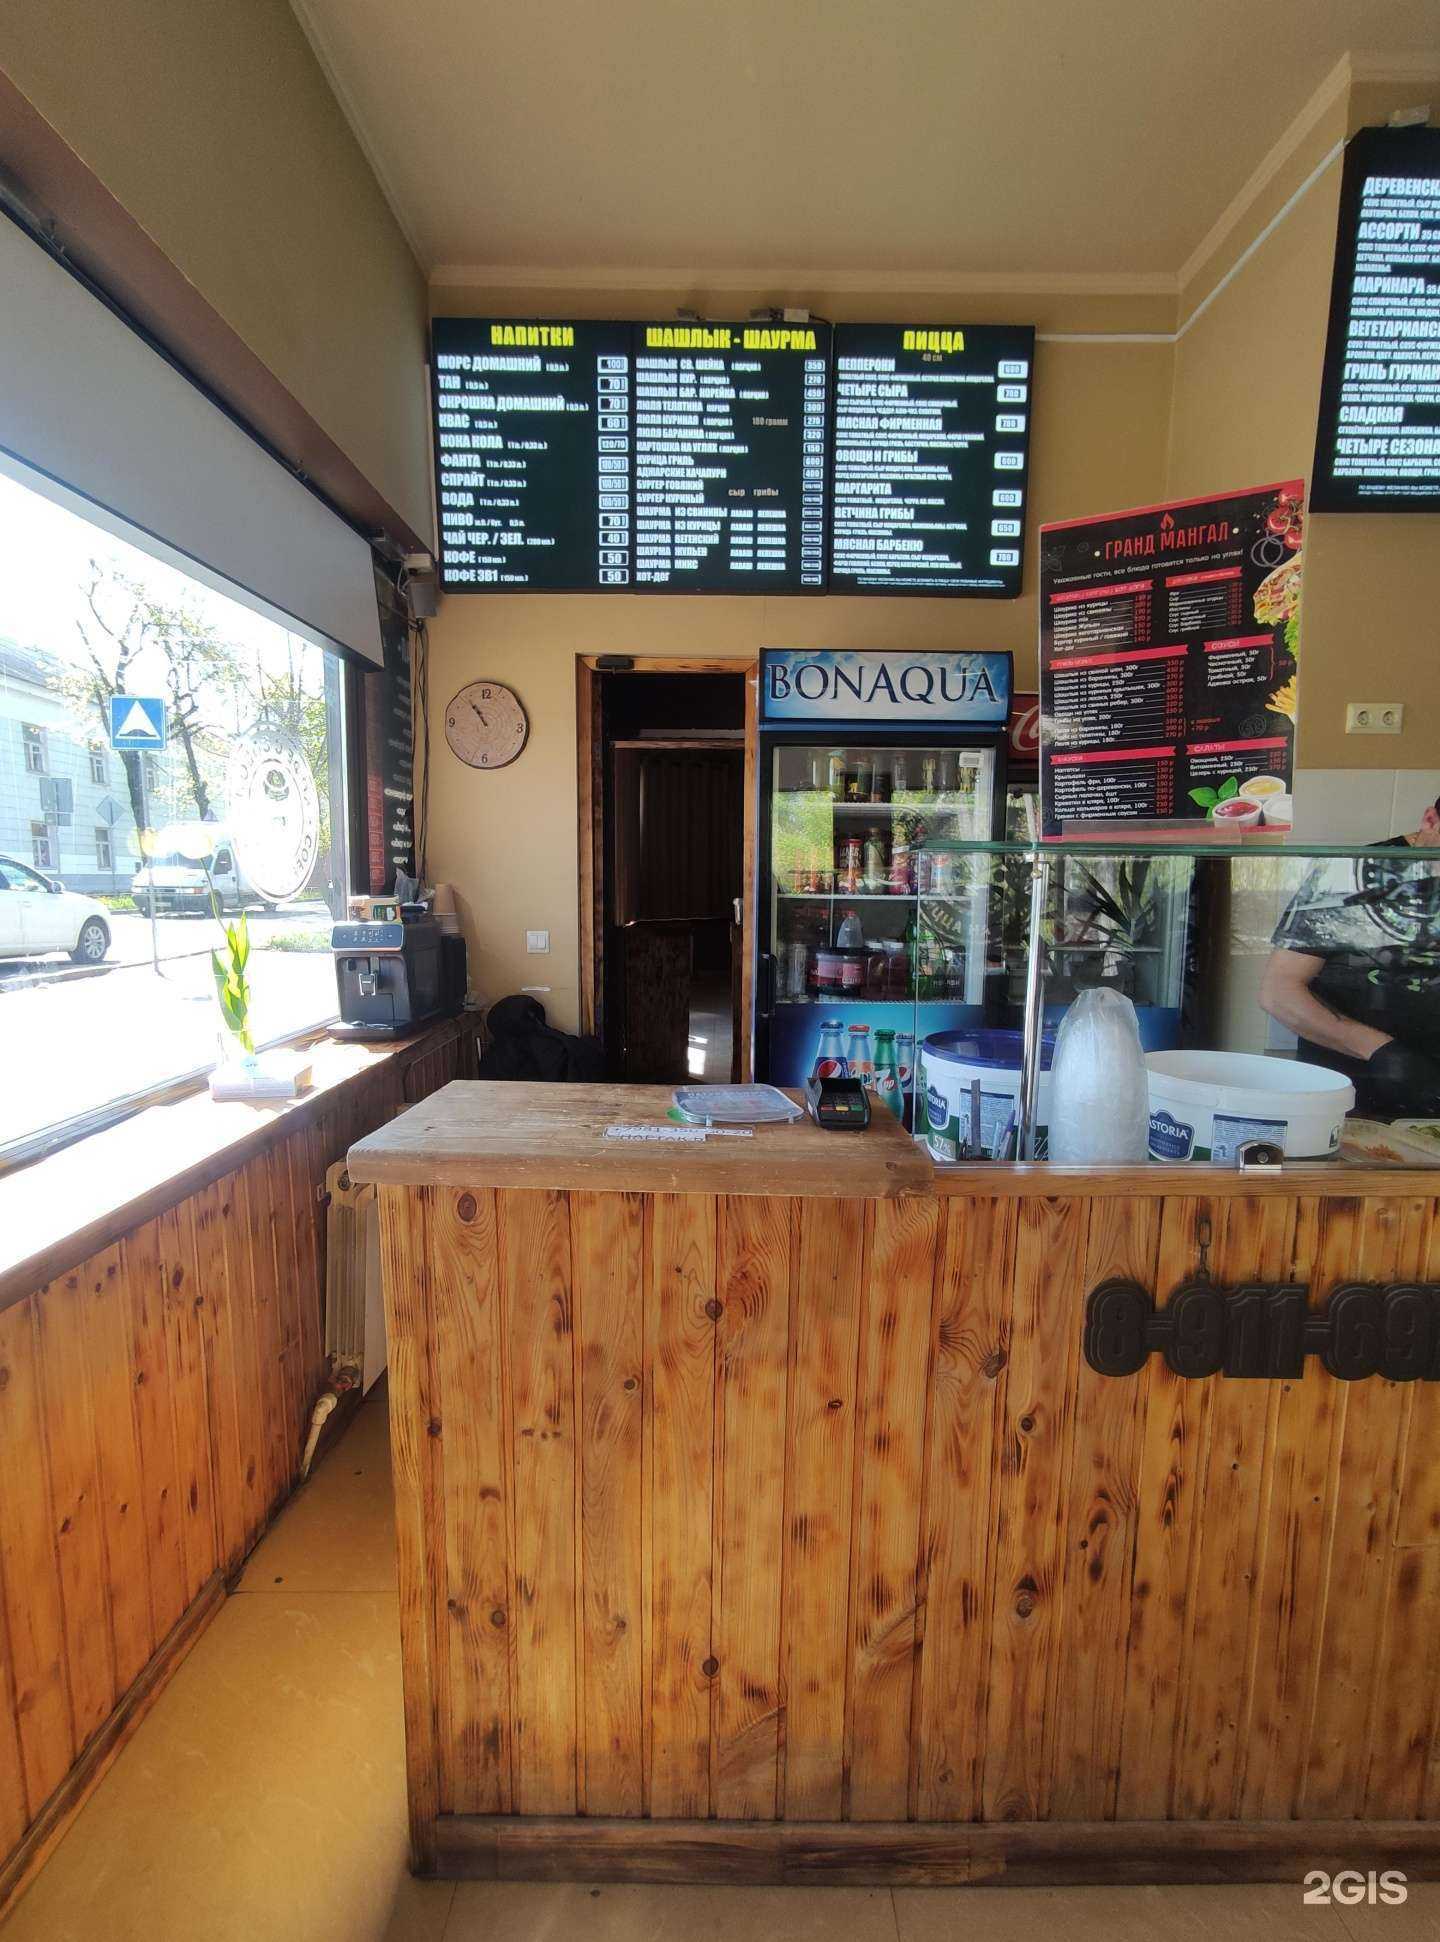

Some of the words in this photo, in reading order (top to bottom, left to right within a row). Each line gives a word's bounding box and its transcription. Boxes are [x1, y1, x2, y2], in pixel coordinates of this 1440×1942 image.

[1358, 222, 1421, 239] АССОРТИ
[1353, 276, 1425, 294] МАРИНАРА
[491, 326, 574, 346] НАПИТКИ
[646, 328, 731, 348] ШАШЛЫК
[744, 330, 816, 350] ШАУРМА
[903, 331, 964, 353] ПИЦЦА
[437, 355, 471, 369] МОРС
[472, 355, 542, 372] ДОМАШНИЙ
[636, 358, 677, 369] ШАШЛЫК
[838, 358, 895, 371] ПЕППЕРОНИ
[636, 372, 677, 383] ШАШЛЫК
[1345, 363, 1386, 379] ГРИЛЬ
[438, 375, 461, 389] ТАН
[636, 386, 677, 397] ШАШЛЫК
[837, 383, 877, 397] ЧЕТЫРЕ
[878, 384, 908, 397] СЫРА
[439, 395, 495, 409] ОКРОШКА
[497, 395, 565, 412] ДОМАШНИЙ
[439, 414, 470, 428] КВАС
[1340, 406, 1404, 424] СЛАДКАЯ
[837, 417, 878, 429] МЯСНАЯ
[879, 417, 942, 430] ФИРМЕННАЯ
[440, 434, 470, 448] КОКА
[472, 435, 503, 448] КОЛА
[1337, 439, 1389, 454] ЧЕТЫРЕ
[441, 454, 481, 468] ФАНТА
[637, 455, 668, 466] КУРИЦА
[669, 455, 694, 465] ГРИЛЬ
[836, 450, 873, 463] ОВОЩИ
[874, 451, 882, 462] И
[883, 451, 918, 463] ГРИБЫ
[441, 471, 485, 487] СПРАЙТ
[728, 489, 745, 497] сыр
[835, 482, 892, 494] МАРГАРИТА
[442, 492, 474, 507] ВОДА
[637, 507, 671, 516] ШАУРМА
[675, 507, 686, 516] ИЗ
[834, 507, 878, 519] ВЕТЧИНА
[879, 508, 914, 519] ГРИБЫ
[443, 513, 473, 526] ПИВО
[637, 520, 671, 530] ШАУРМА
[675, 521, 685, 530] ИЗ
[443, 530, 466, 545] ЧАЙ
[468, 532, 491, 545] ЧЕР.
[501, 533, 524, 545] ЗЕЛ.
[637, 534, 671, 543] ШАУРМА
[1105, 535, 1155, 560] ГРАНД
[1161, 522, 1228, 550] МАНГАЛ
[637, 546, 671, 556] ШАУРМА
[834, 539, 875, 550] МЯСНАЯ
[876, 539, 923, 551] БАРБЕКЮ
[444, 551, 475, 564] КОФЕ
[637, 559, 671, 569] ШАУРМА
[444, 569, 476, 582] КОФЕ
[767, 663, 1001, 704] BONAQUA
[482, 689, 491, 699] 12
[449, 717, 455, 727] 9
[517, 723, 523, 733] 3
[482, 754, 488, 763] 6
[1084, 1278, 1440, 1381] 8-911-69
